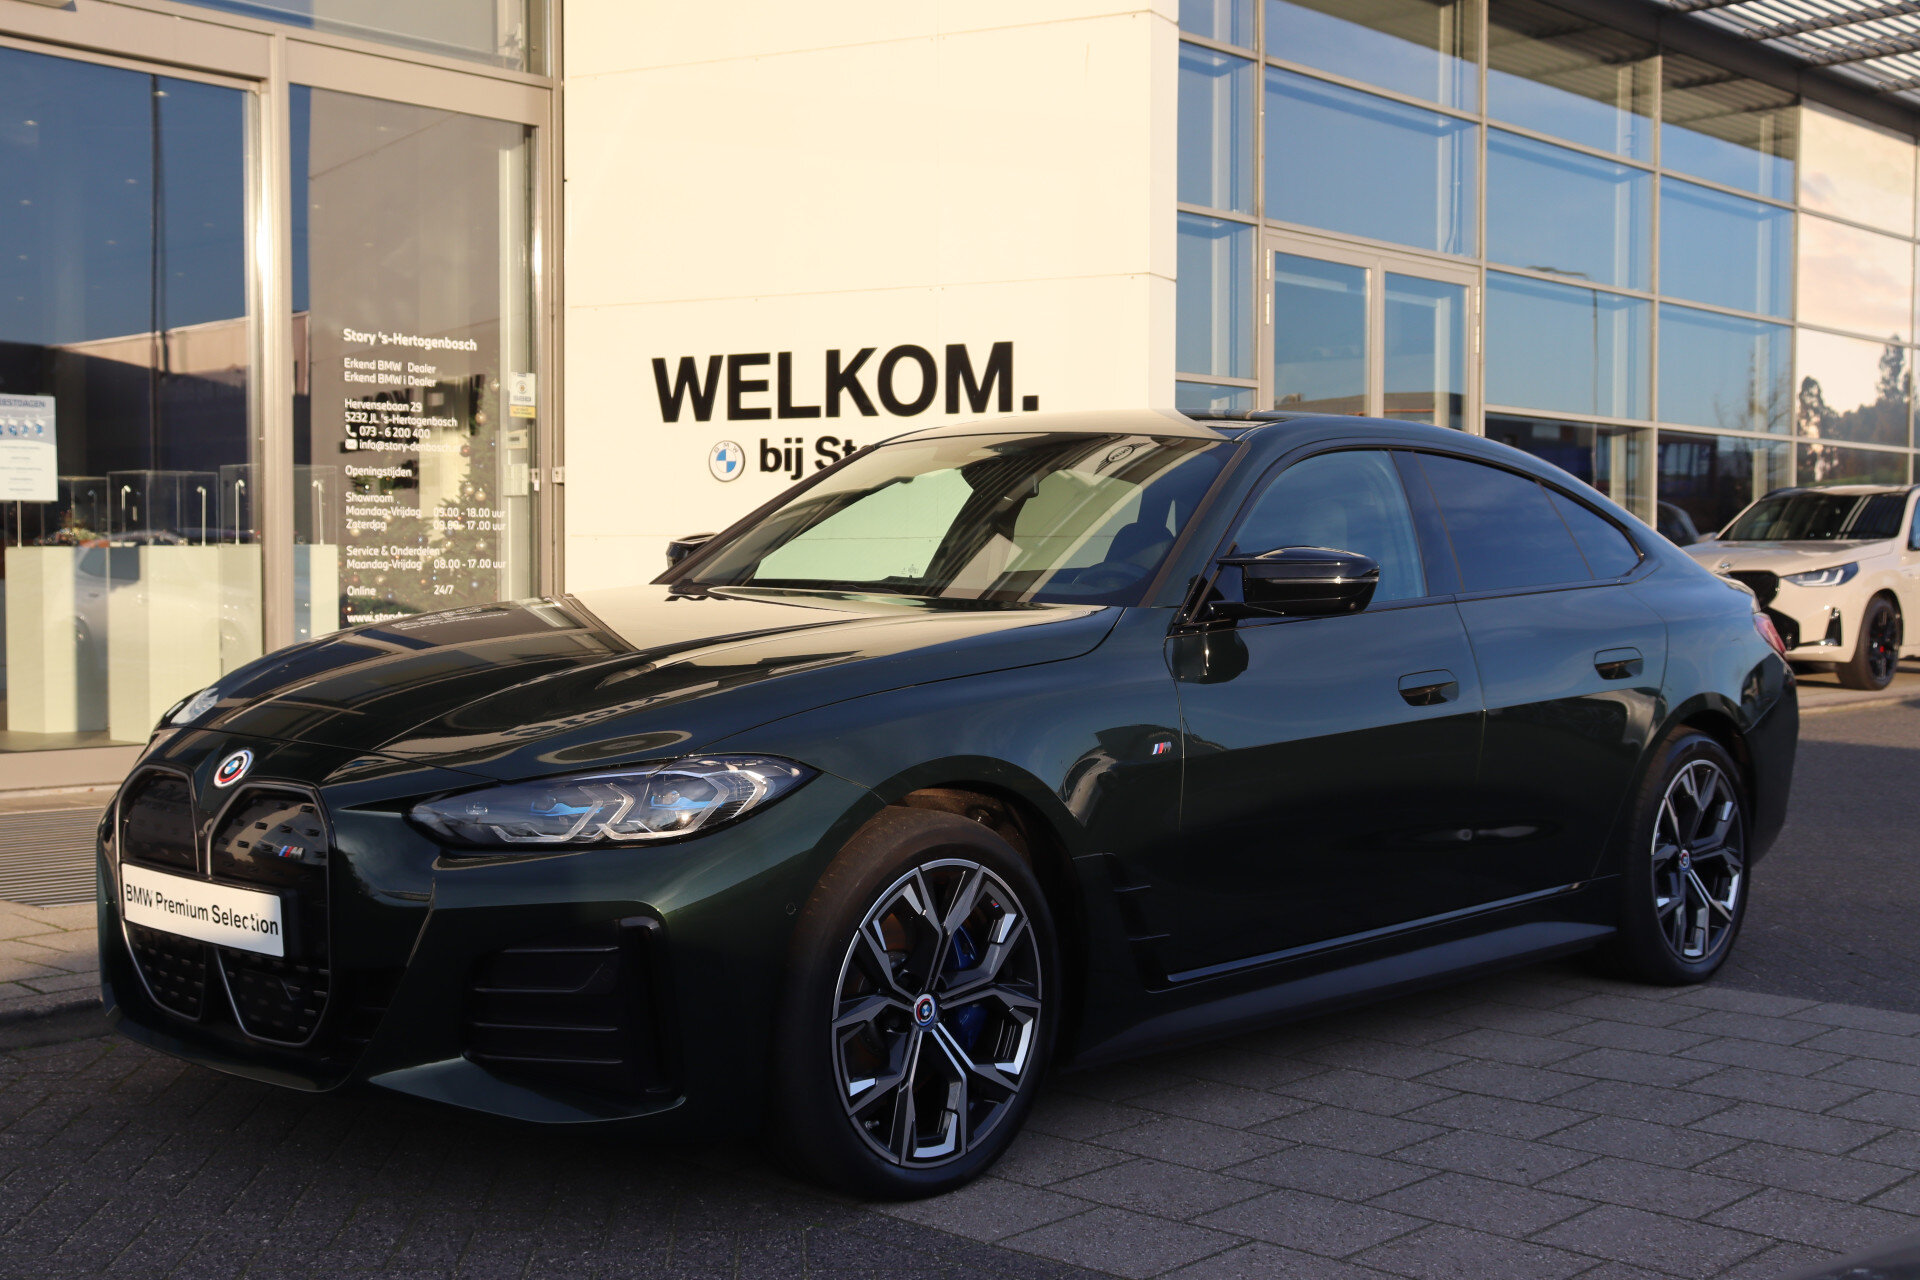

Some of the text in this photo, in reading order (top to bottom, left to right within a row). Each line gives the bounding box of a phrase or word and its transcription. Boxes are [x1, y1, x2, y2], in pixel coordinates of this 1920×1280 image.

[343, 328, 478, 351] Story 's-Hertogenbosch
[344, 357, 437, 374] Erkend BMW Dealer
[344, 371, 376, 383] Erkend
[377, 372, 402, 385] BMW
[407, 374, 437, 387] Dealer
[651, 341, 1040, 423] WELKOM.
[344, 398, 423, 413] Hervensebaan 29
[344, 411, 458, 428] 5232 JL 's-Hertogenbosch
[359, 425, 378, 437] 073
[384, 427, 392, 438] 6
[392, 427, 411, 439] 200
[412, 428, 431, 439] 400
[759, 435, 873, 480] bij St
[345, 464, 413, 478] Openingstijden
[345, 491, 394, 503] Showroom
[345, 505, 422, 518] Maandag-Vrijdag
[433, 507, 459, 518] 09.00
[466, 507, 490, 518] 18.00
[491, 510, 506, 518] uur
[345, 518, 387, 531] Zaterdag
[492, 523, 506, 531] uur
[346, 545, 440, 558] Service & Onderdelen
[346, 558, 423, 571] Maandag-Vrijdag
[433, 559, 460, 570] 08.00
[467, 559, 492, 570] 17.00
[493, 562, 507, 570] uur
[346, 584, 455, 597] Online 24/7
[125, 883, 279, 936] BMW Premium Selection
